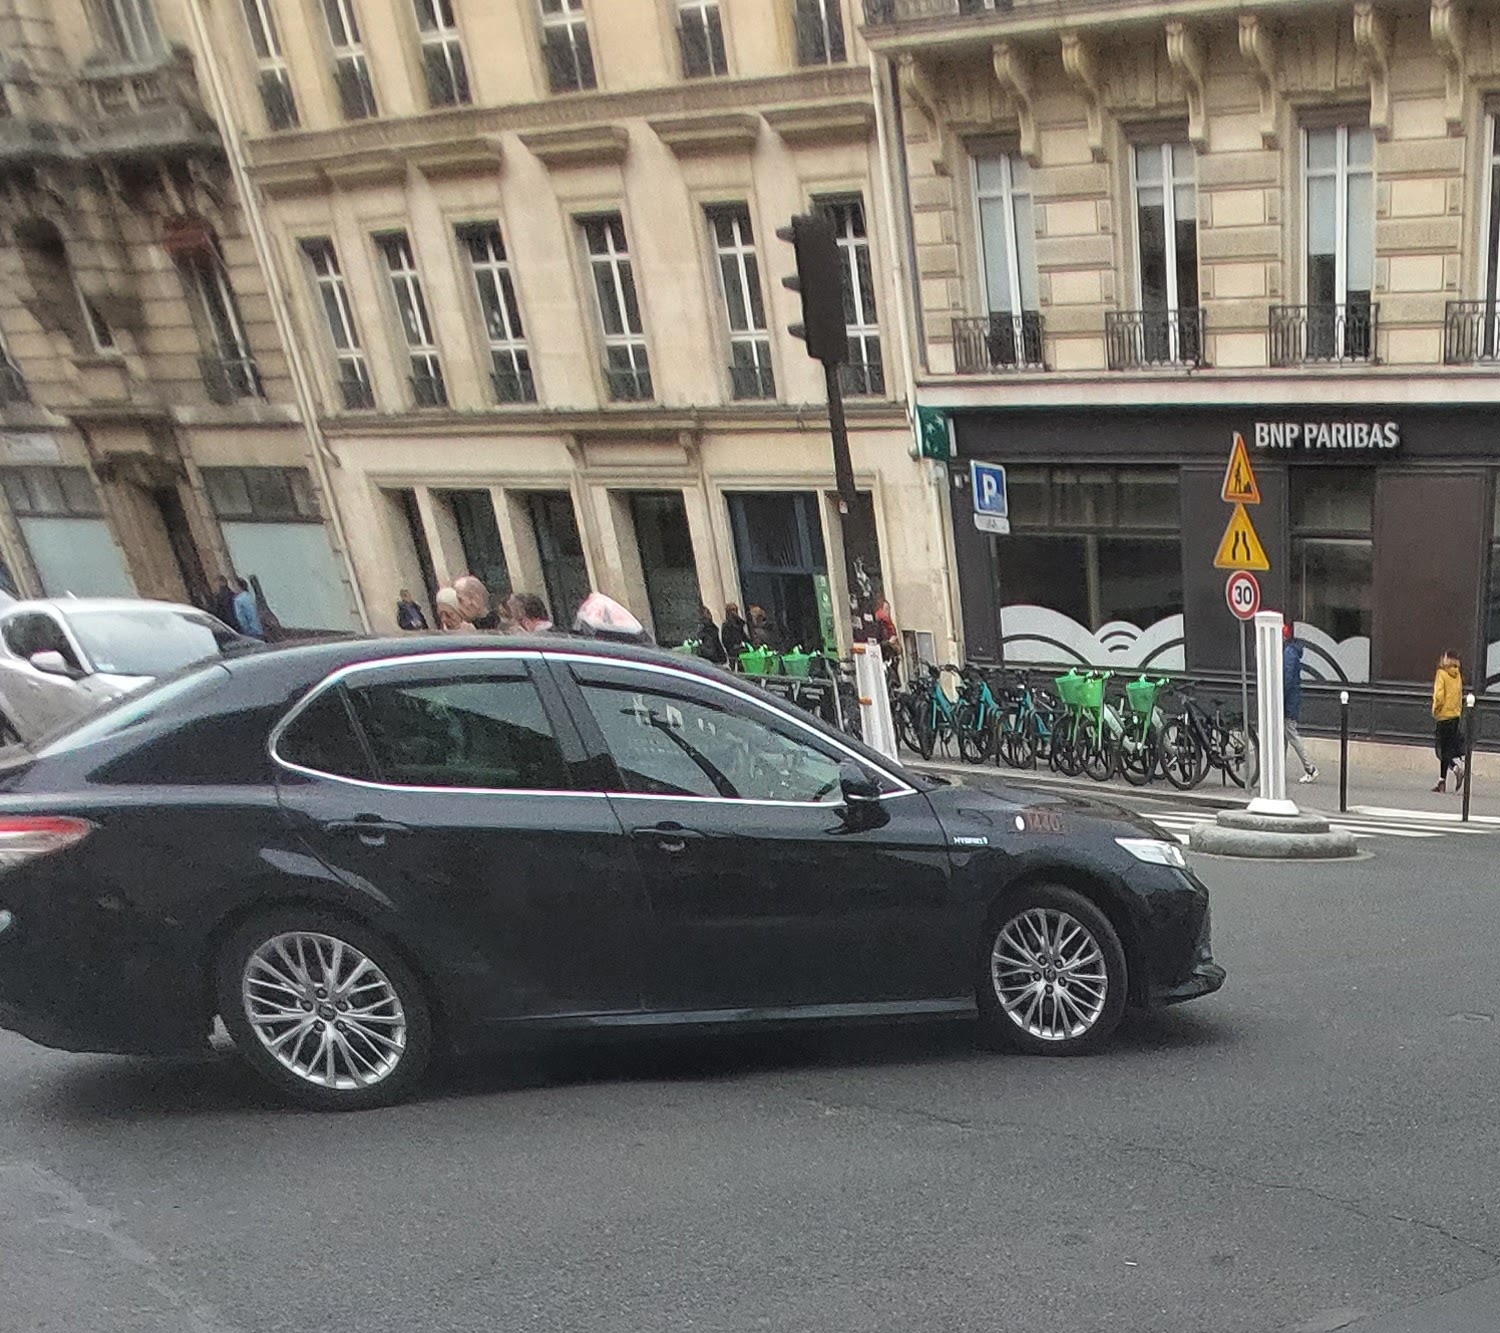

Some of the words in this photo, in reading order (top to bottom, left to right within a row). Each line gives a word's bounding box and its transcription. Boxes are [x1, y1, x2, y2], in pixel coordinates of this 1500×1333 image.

[1255, 422, 1300, 449] BNP
[1304, 421, 1400, 449] PARIBAS
[983, 473, 998, 505] P
[1235, 585, 1252, 605] 30
